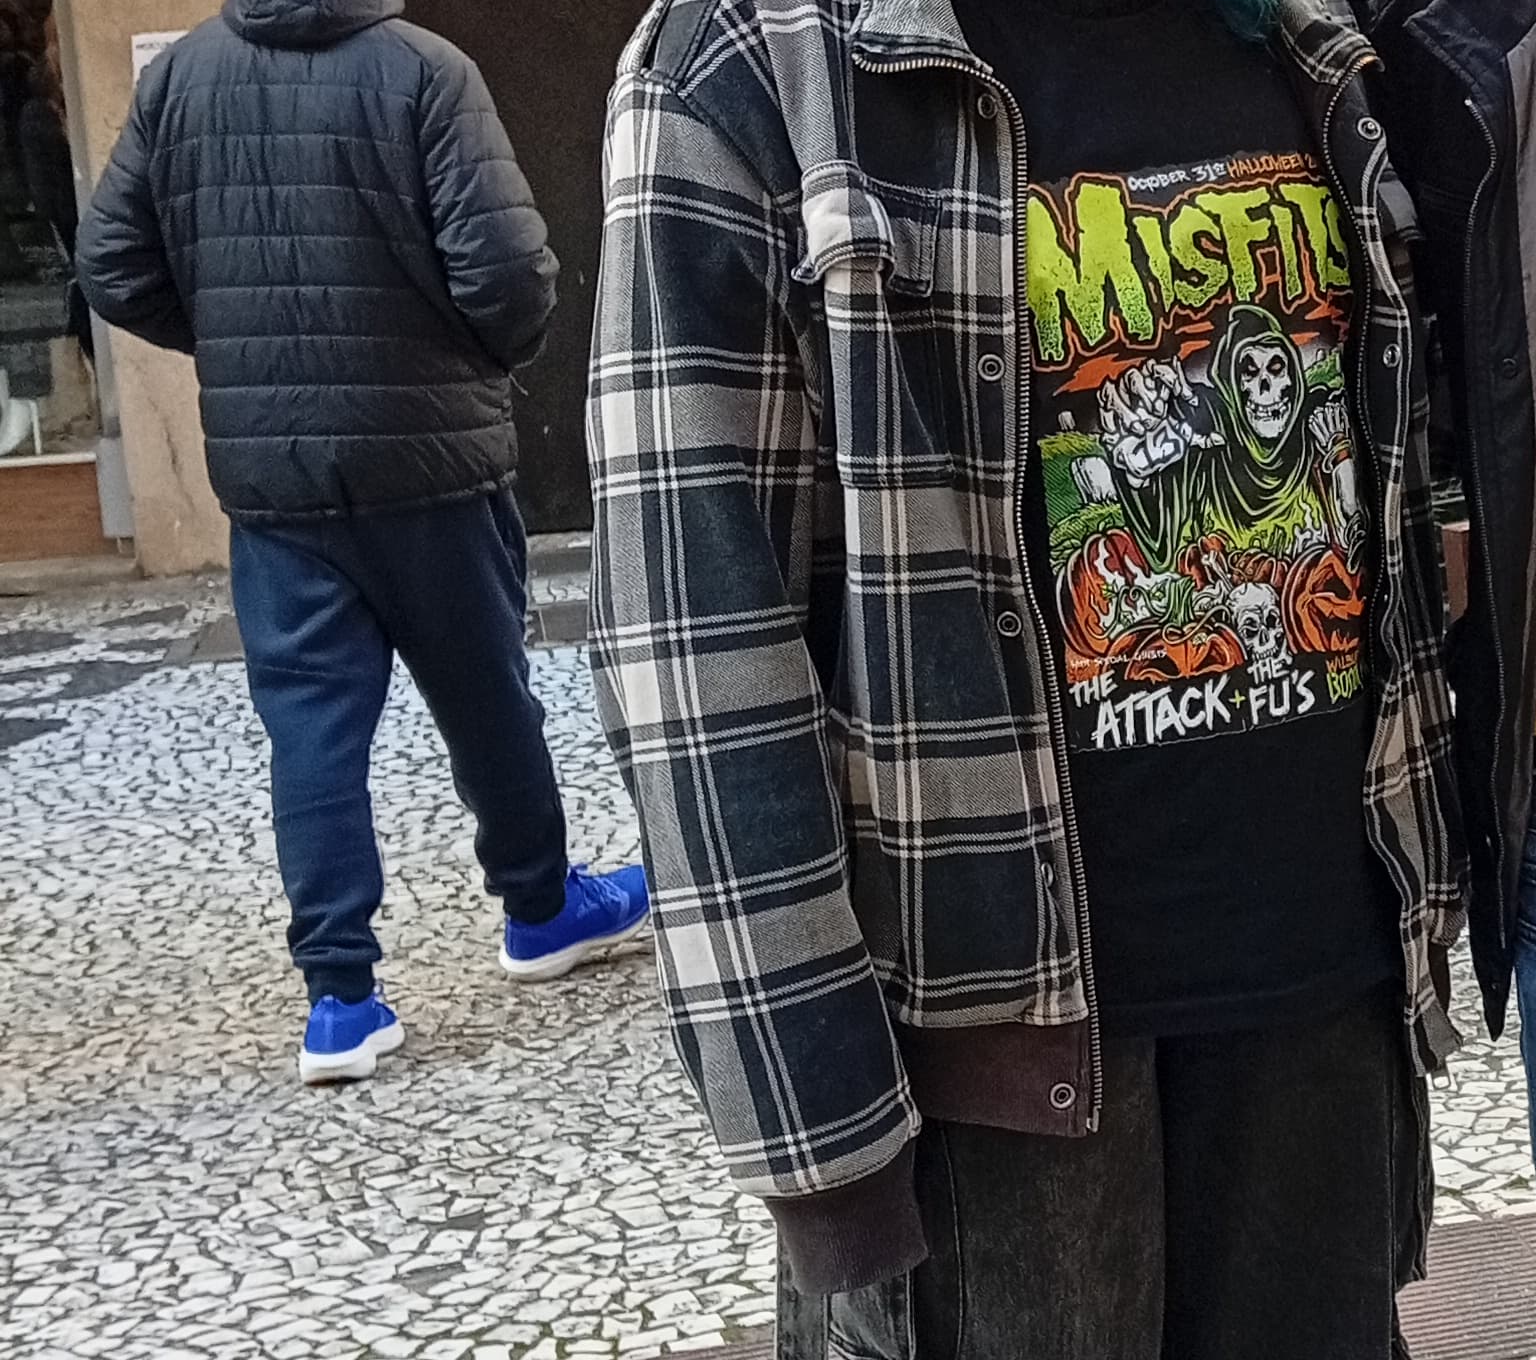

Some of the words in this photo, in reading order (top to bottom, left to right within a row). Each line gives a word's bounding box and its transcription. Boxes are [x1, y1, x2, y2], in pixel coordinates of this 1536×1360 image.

[1069, 670, 1119, 708] THE
[1247, 656, 1290, 685] THE
[1090, 673, 1232, 749] ATTACK
[1248, 670, 1316, 725] FU'S
